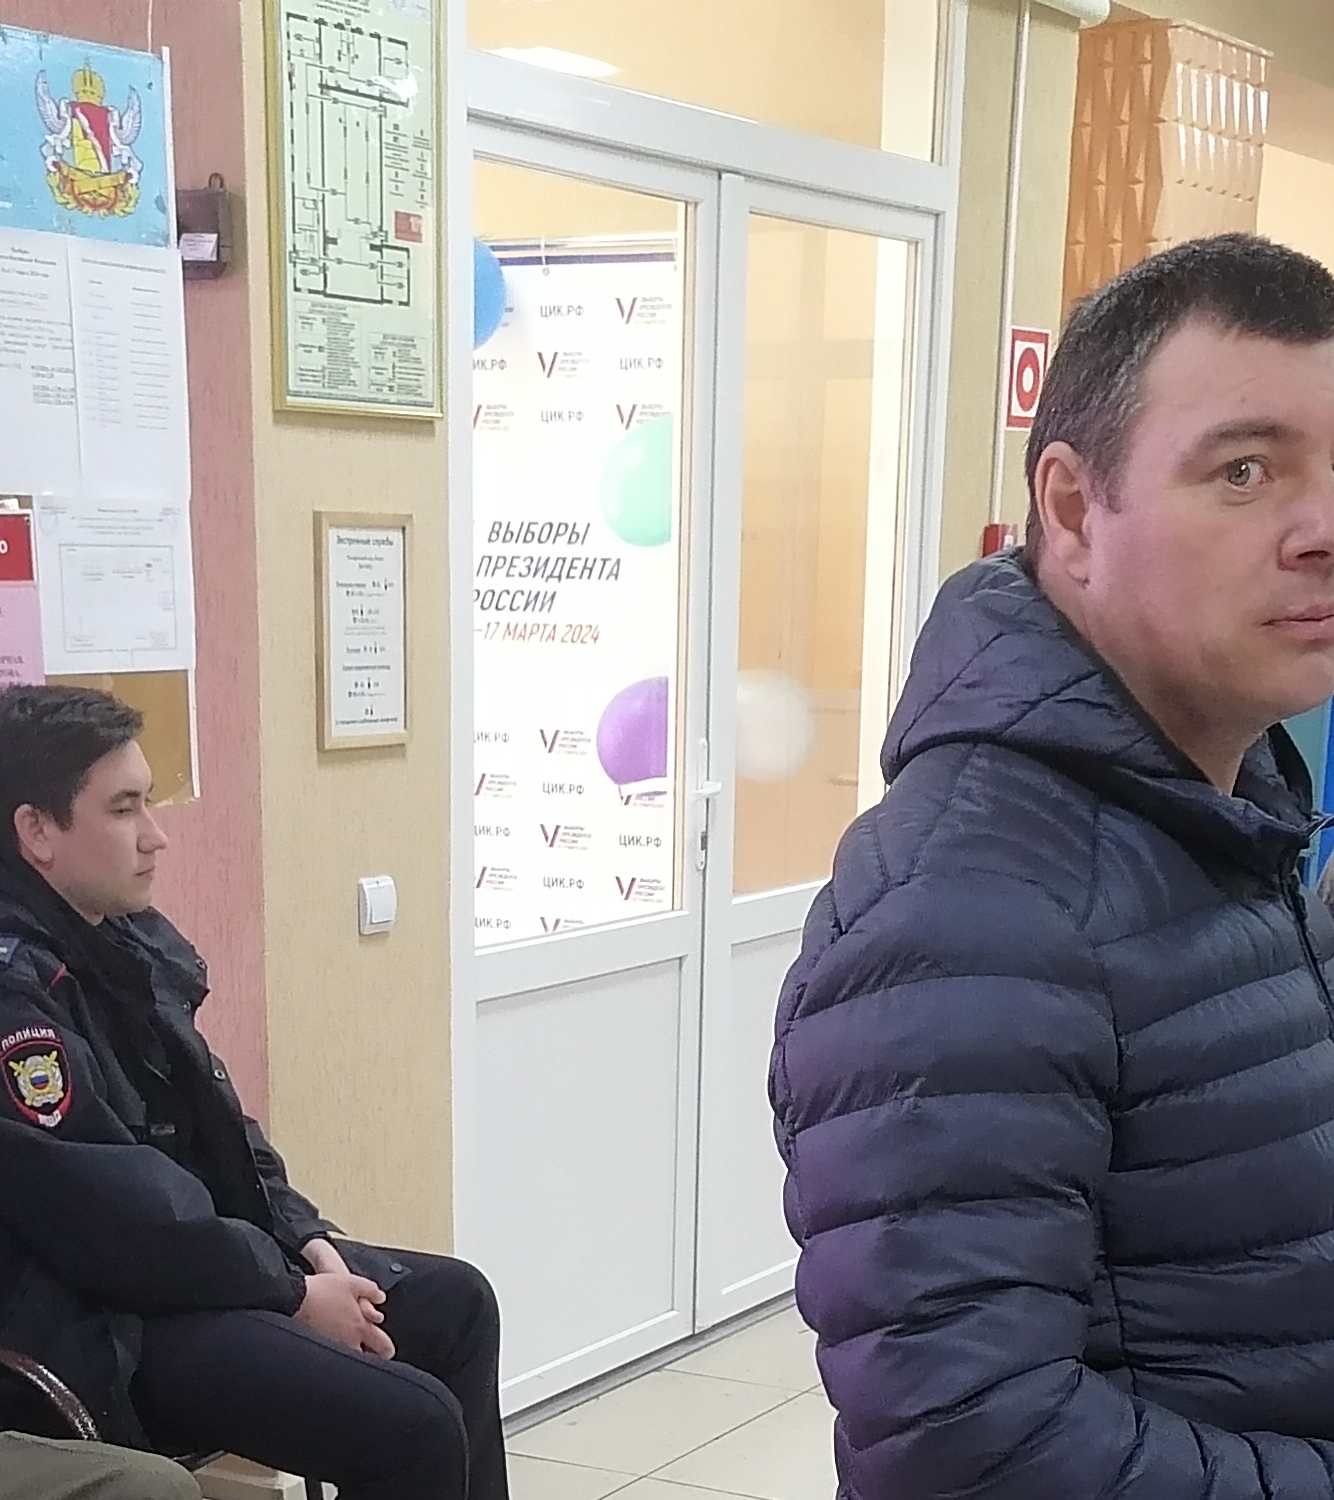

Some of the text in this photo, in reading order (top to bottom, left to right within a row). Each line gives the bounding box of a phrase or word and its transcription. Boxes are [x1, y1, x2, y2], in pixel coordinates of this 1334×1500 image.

[487, 521, 591, 546] ВЫБОРЫ
[475, 555, 622, 583] ПРЕЗИДЕНТА
[502, 622, 557, 644] МАРТА
[561, 623, 601, 645] 2024
[474, 732, 509, 743] ИК.РФ
[543, 783, 584, 795] ЦИК.РФ
[620, 835, 661, 847] ЦИК.РФ
[544, 877, 583, 889] ЦИК.РФ
[0, 1026, 56, 1051] ПОЛИЦИЯ
